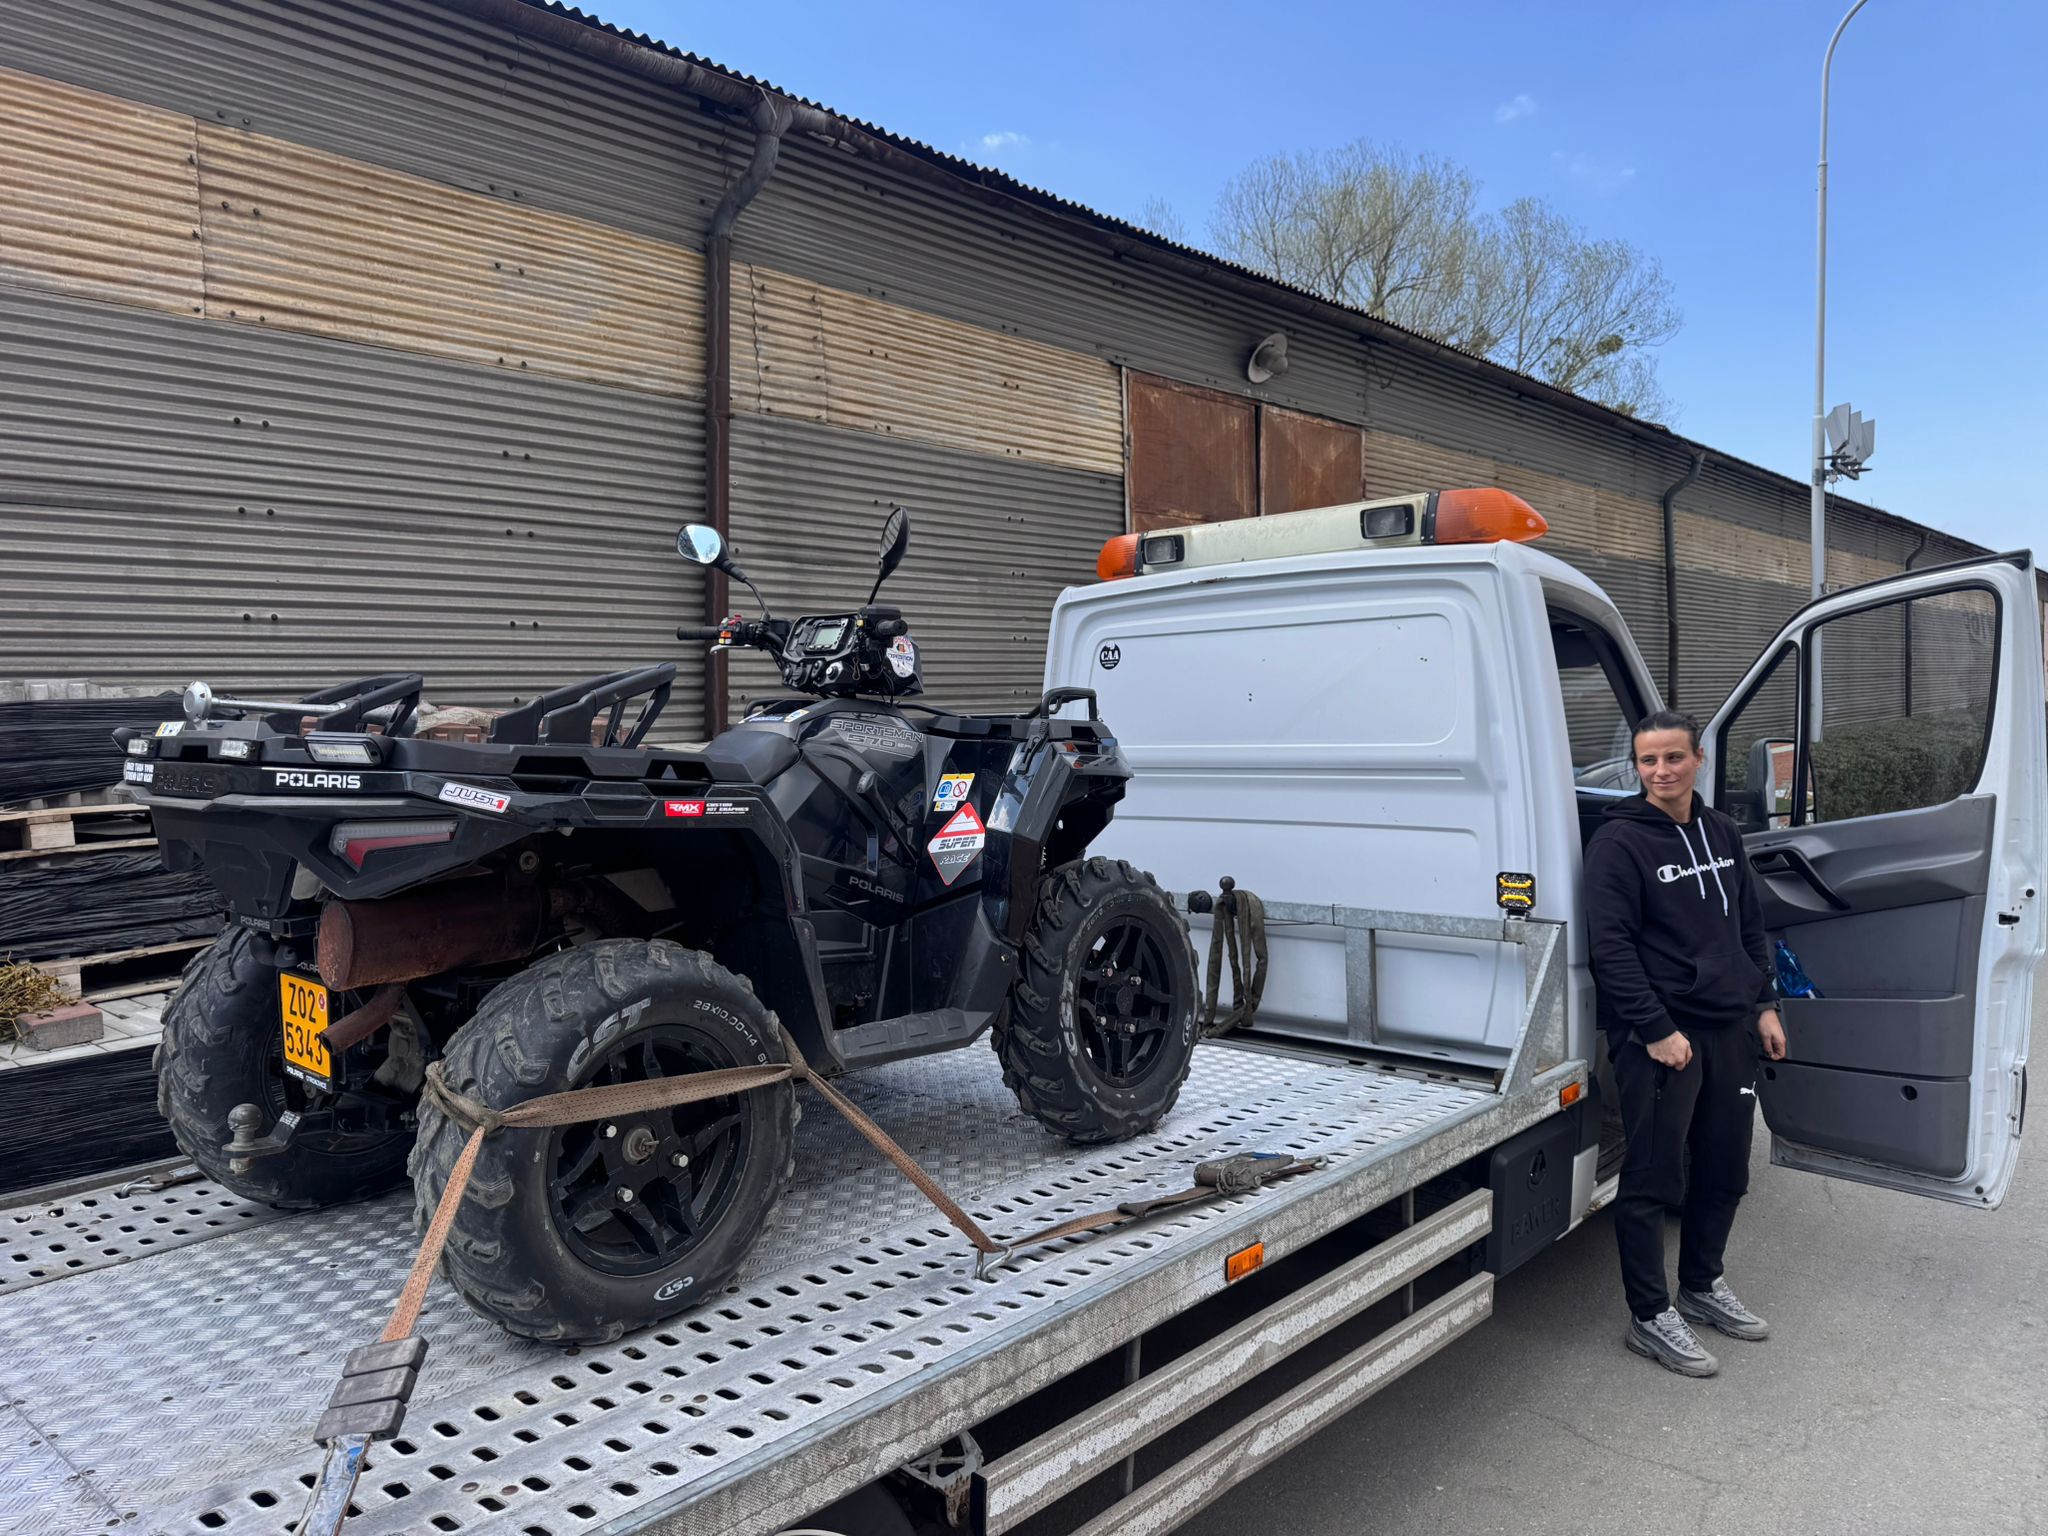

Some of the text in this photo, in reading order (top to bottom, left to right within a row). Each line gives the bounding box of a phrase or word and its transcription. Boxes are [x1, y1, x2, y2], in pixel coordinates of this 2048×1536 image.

[830, 719, 923, 742] SPORTSMAN
[848, 733, 896, 748] 570
[276, 772, 361, 789] POLARIS
[938, 836, 977, 850] SUPER
[940, 853, 971, 865] RACE
[849, 876, 904, 903] POLARIS
[240, 915, 271, 930] POLARIS
[288, 981, 317, 1024] Z02
[285, 1020, 323, 1066] 5343
[566, 997, 651, 1083] CST
[663, 1276, 694, 1297] CST
